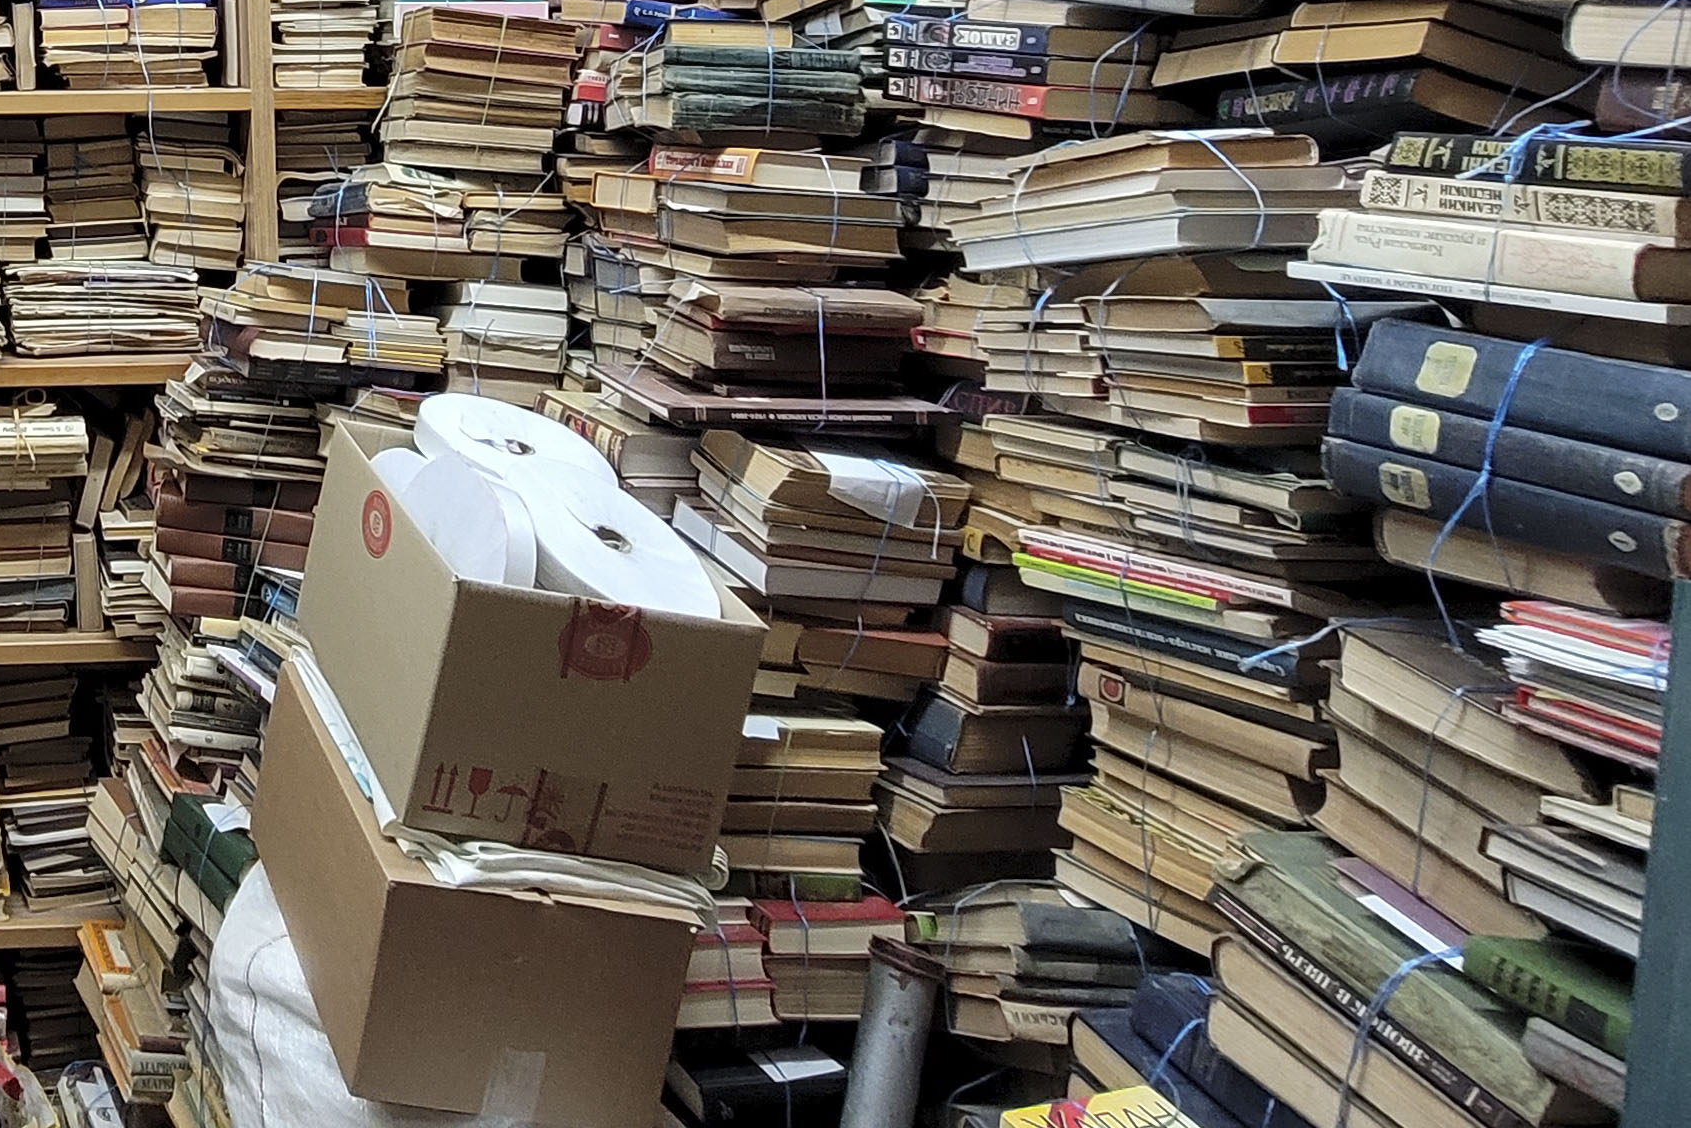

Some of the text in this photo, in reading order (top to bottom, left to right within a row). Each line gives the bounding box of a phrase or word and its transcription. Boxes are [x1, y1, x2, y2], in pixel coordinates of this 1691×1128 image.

[955, 28, 1020, 49] ЗАМОК
[1440, 183, 1502, 200] НЕСПОКІЙ
[1439, 198, 1502, 215] ВЕЛИКИЙ
[1281, 943, 1331, 990] ДВЕРЬ
